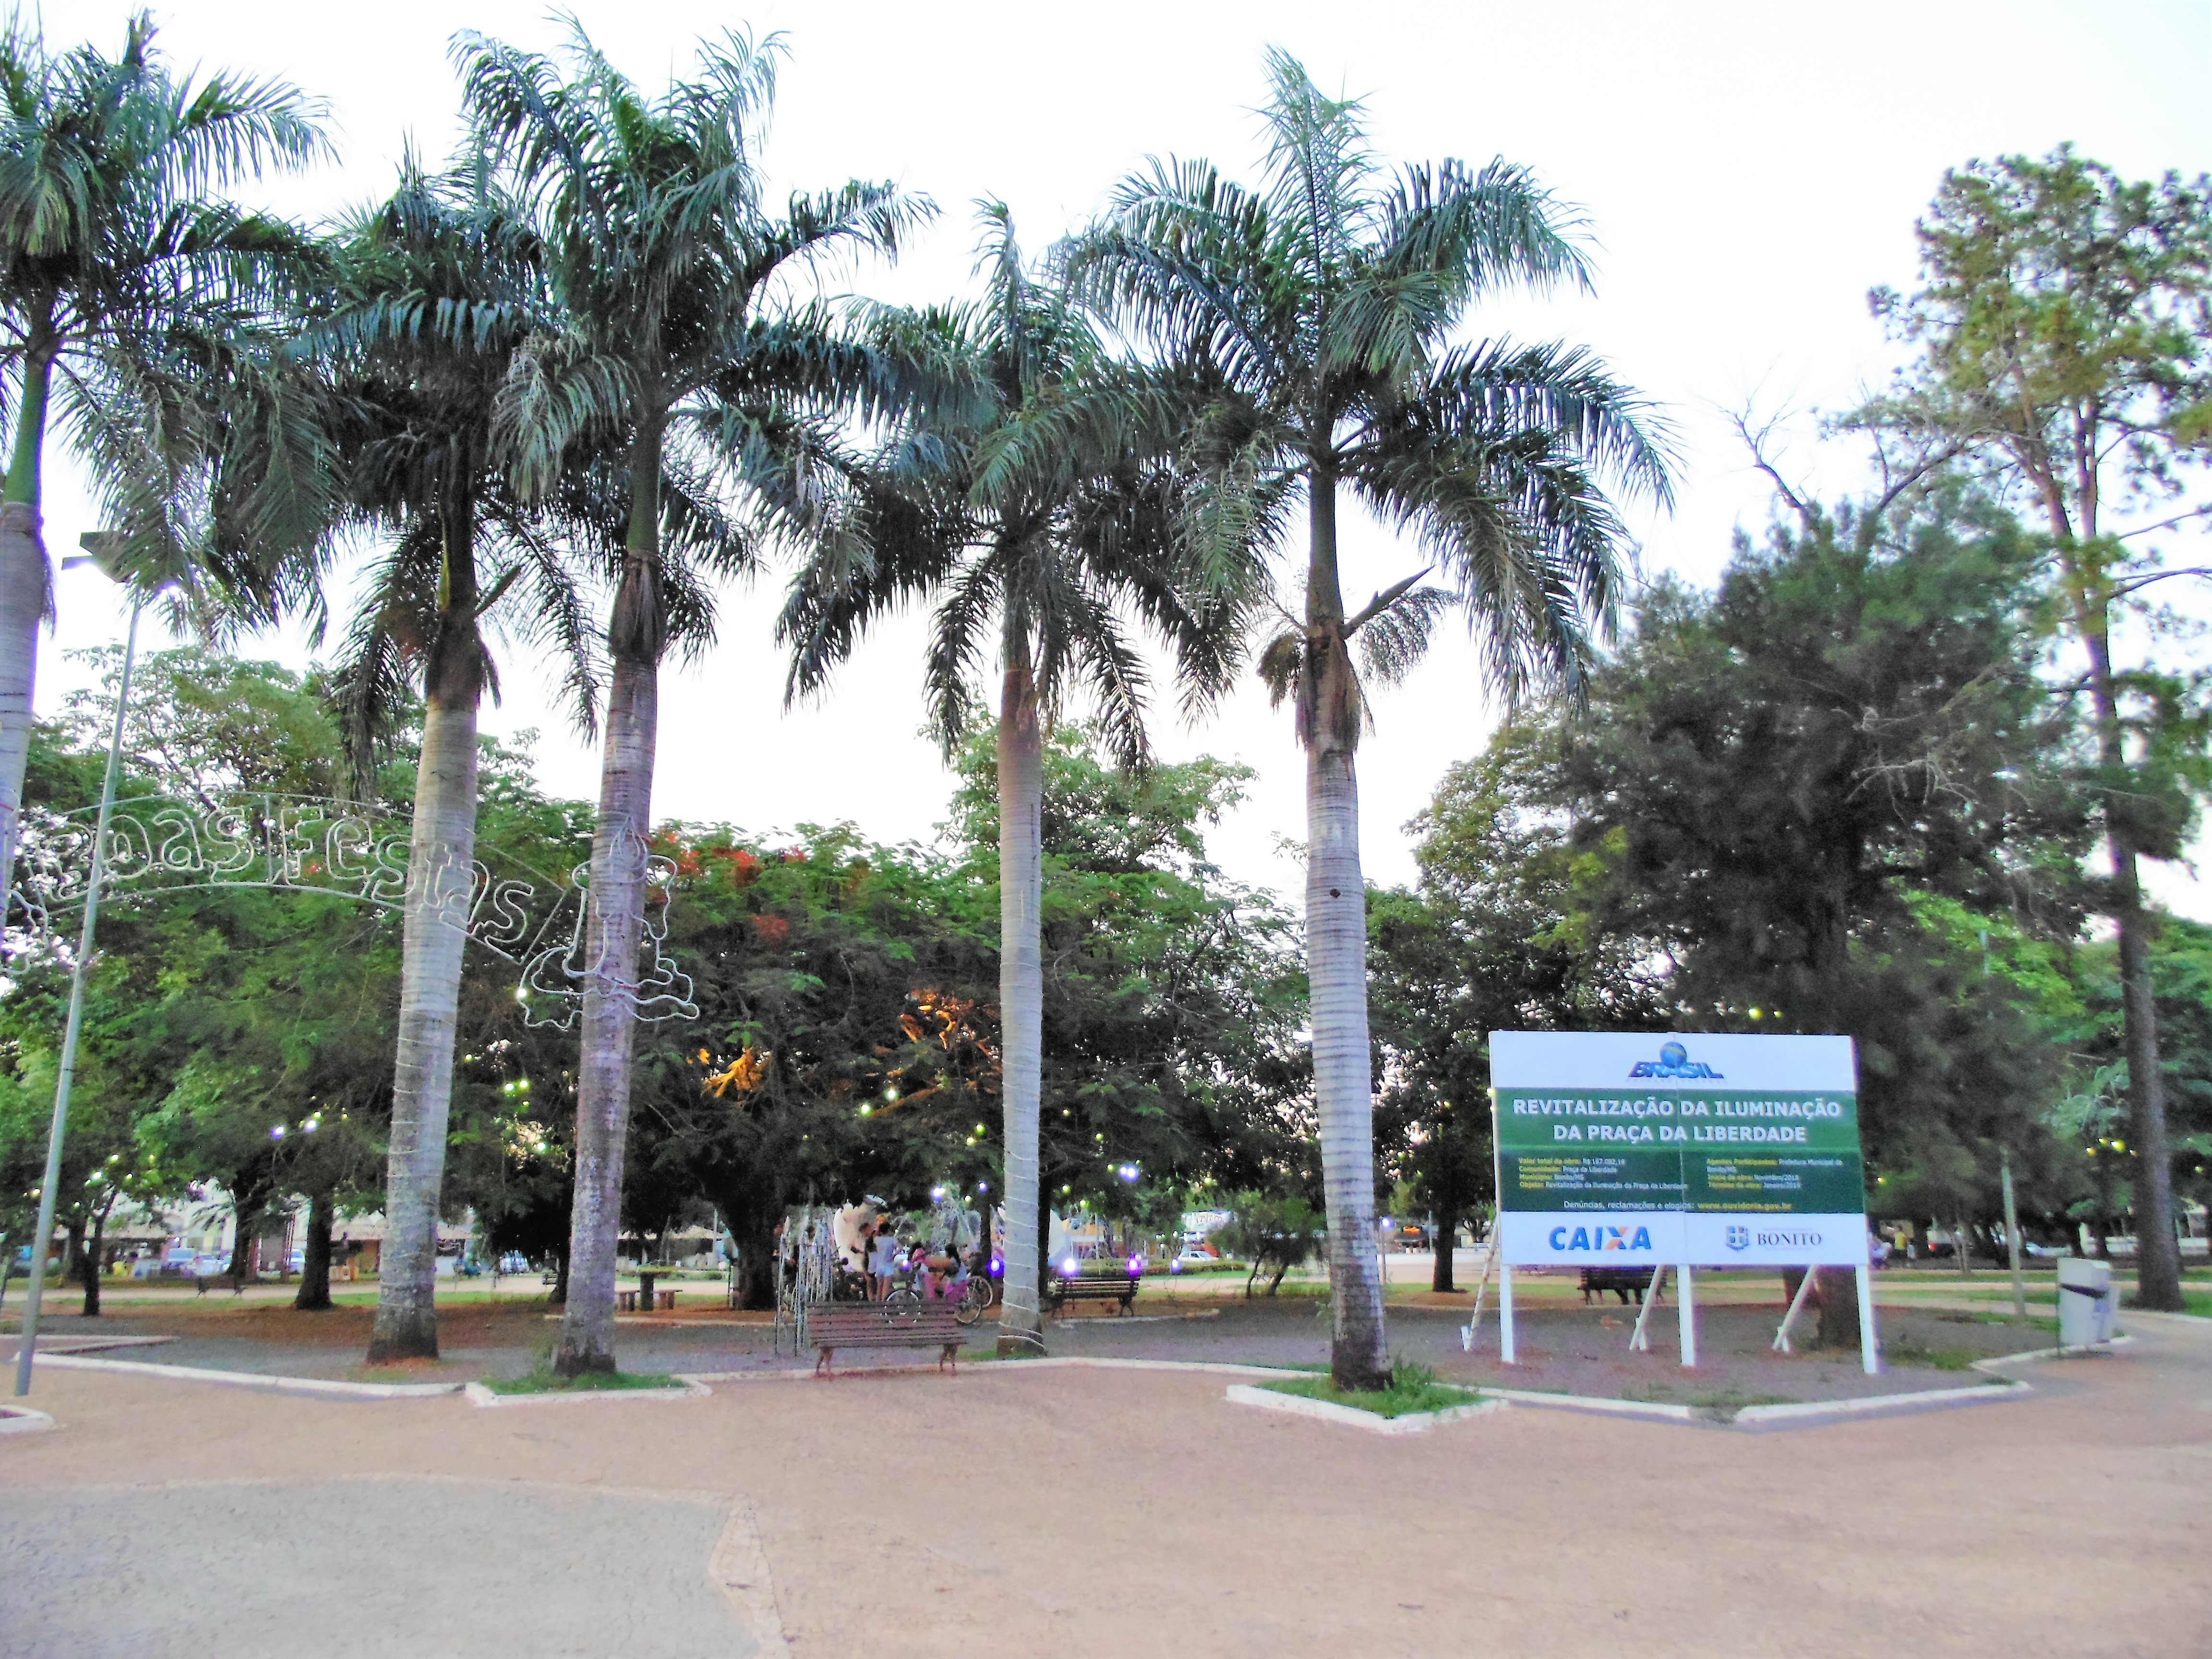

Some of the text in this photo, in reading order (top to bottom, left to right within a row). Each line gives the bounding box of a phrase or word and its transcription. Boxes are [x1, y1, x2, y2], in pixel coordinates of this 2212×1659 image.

[1628, 1062, 1724, 1078] BRASIL
[1513, 1096, 1840, 1119] REVITALIZAÇÃO DA ILUMINAÇÃO
[1553, 1125, 1807, 1143] DA PRAÇA DA LIBERDADE
[1563, 1200, 1605, 1209] Denúncias,
[1608, 1201, 1655, 1210] reclamações
[1549, 1226, 1651, 1250] CAIXA
[1758, 1233, 1821, 1245] BONITO
